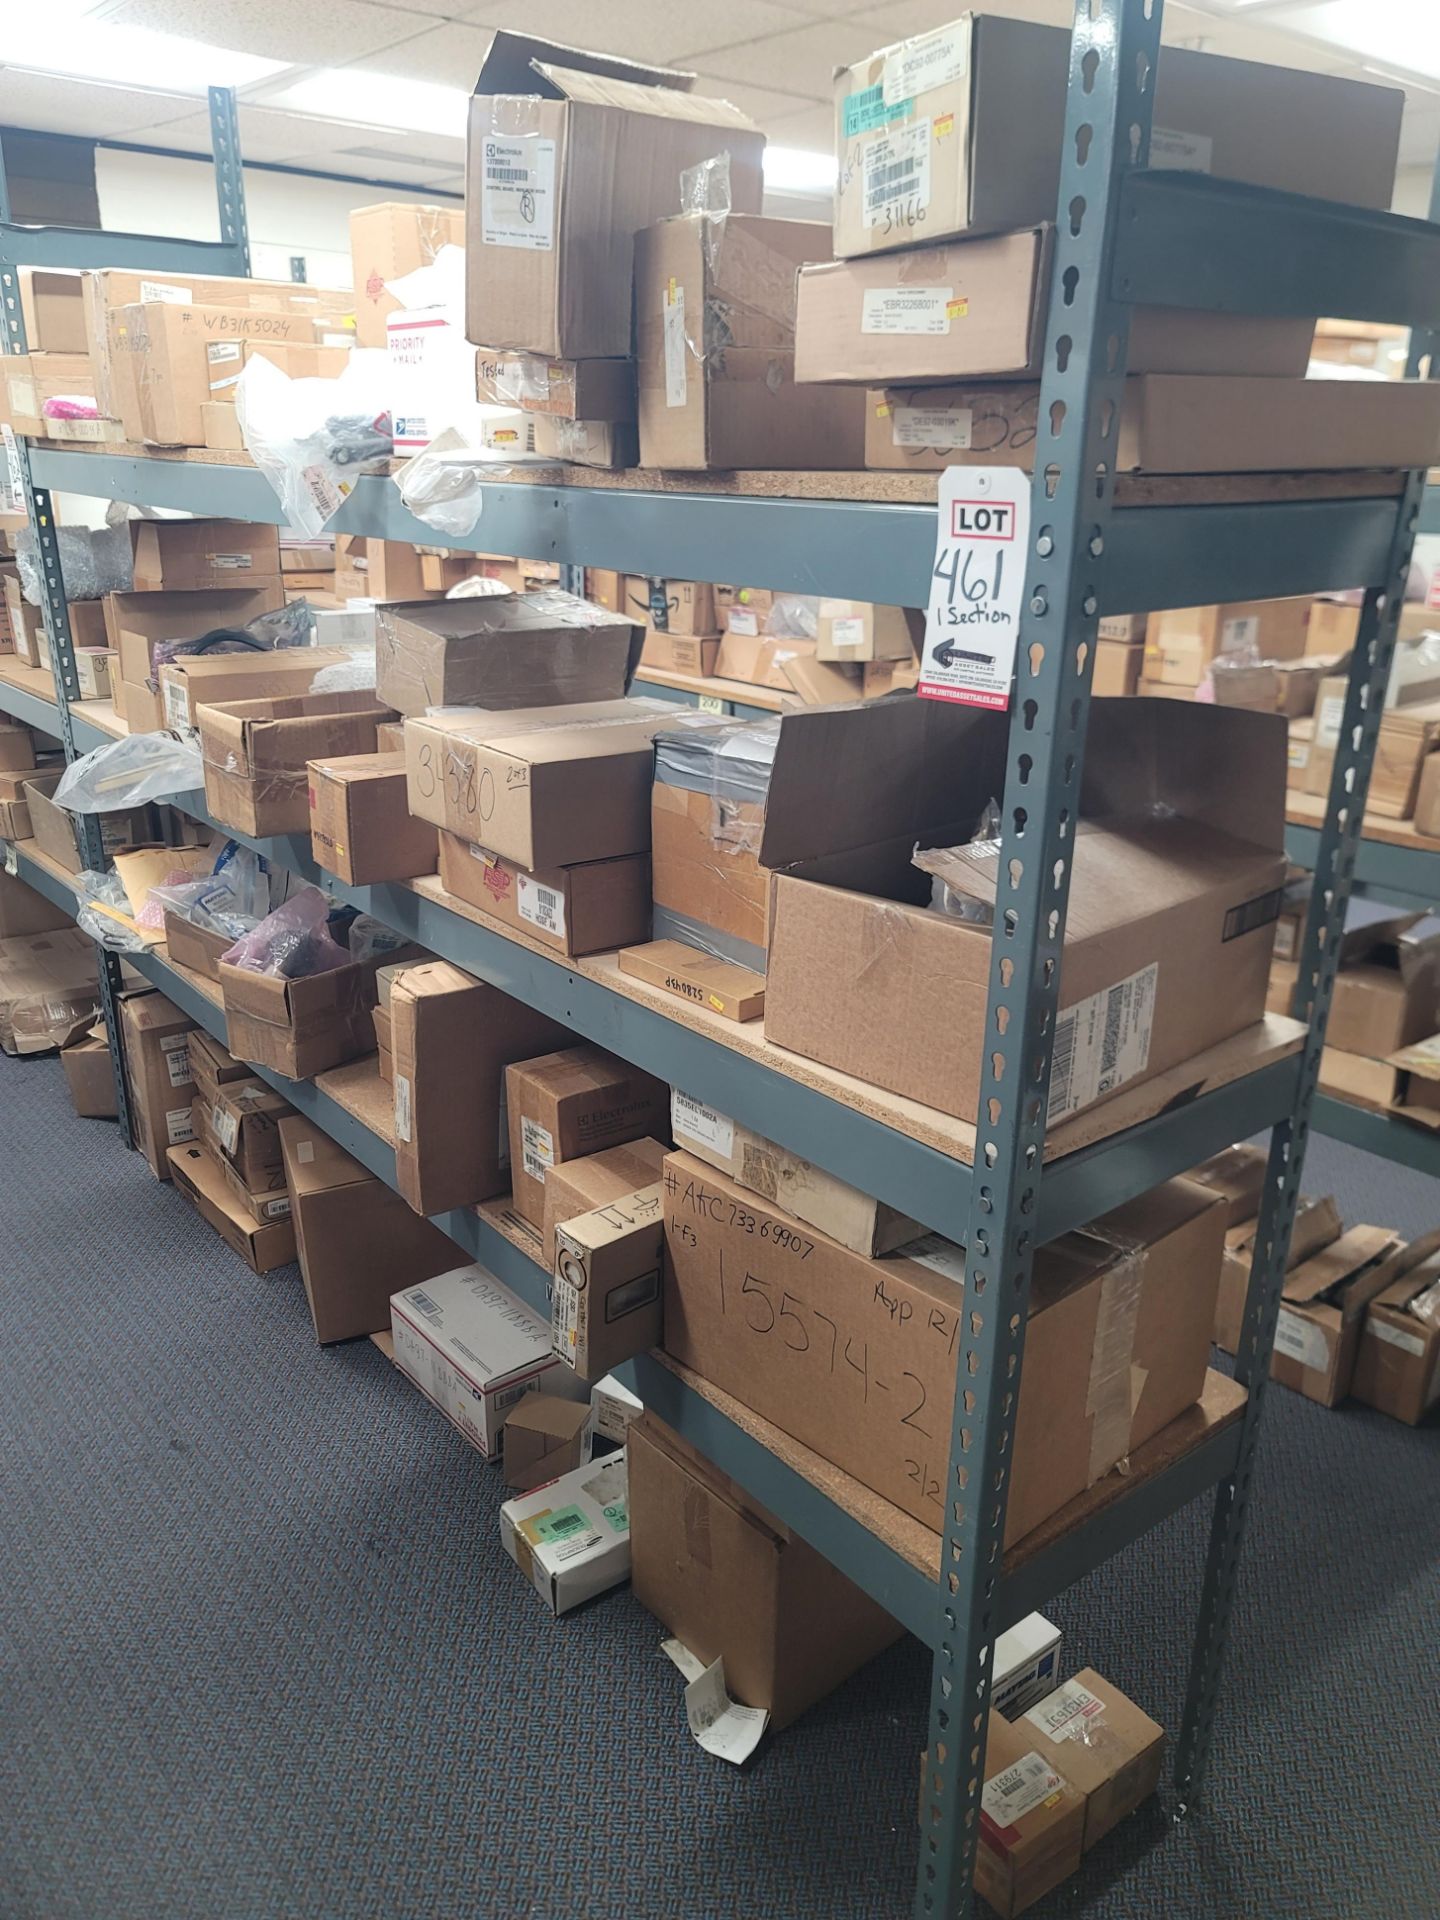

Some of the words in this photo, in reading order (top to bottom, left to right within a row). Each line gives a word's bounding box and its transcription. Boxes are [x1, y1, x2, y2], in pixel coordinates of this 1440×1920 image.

[390, 336, 426, 351] PRIORITY
[959, 507, 1009, 533] LOT
[933, 548, 1004, 604] 461
[947, 603, 1011, 626] Section
